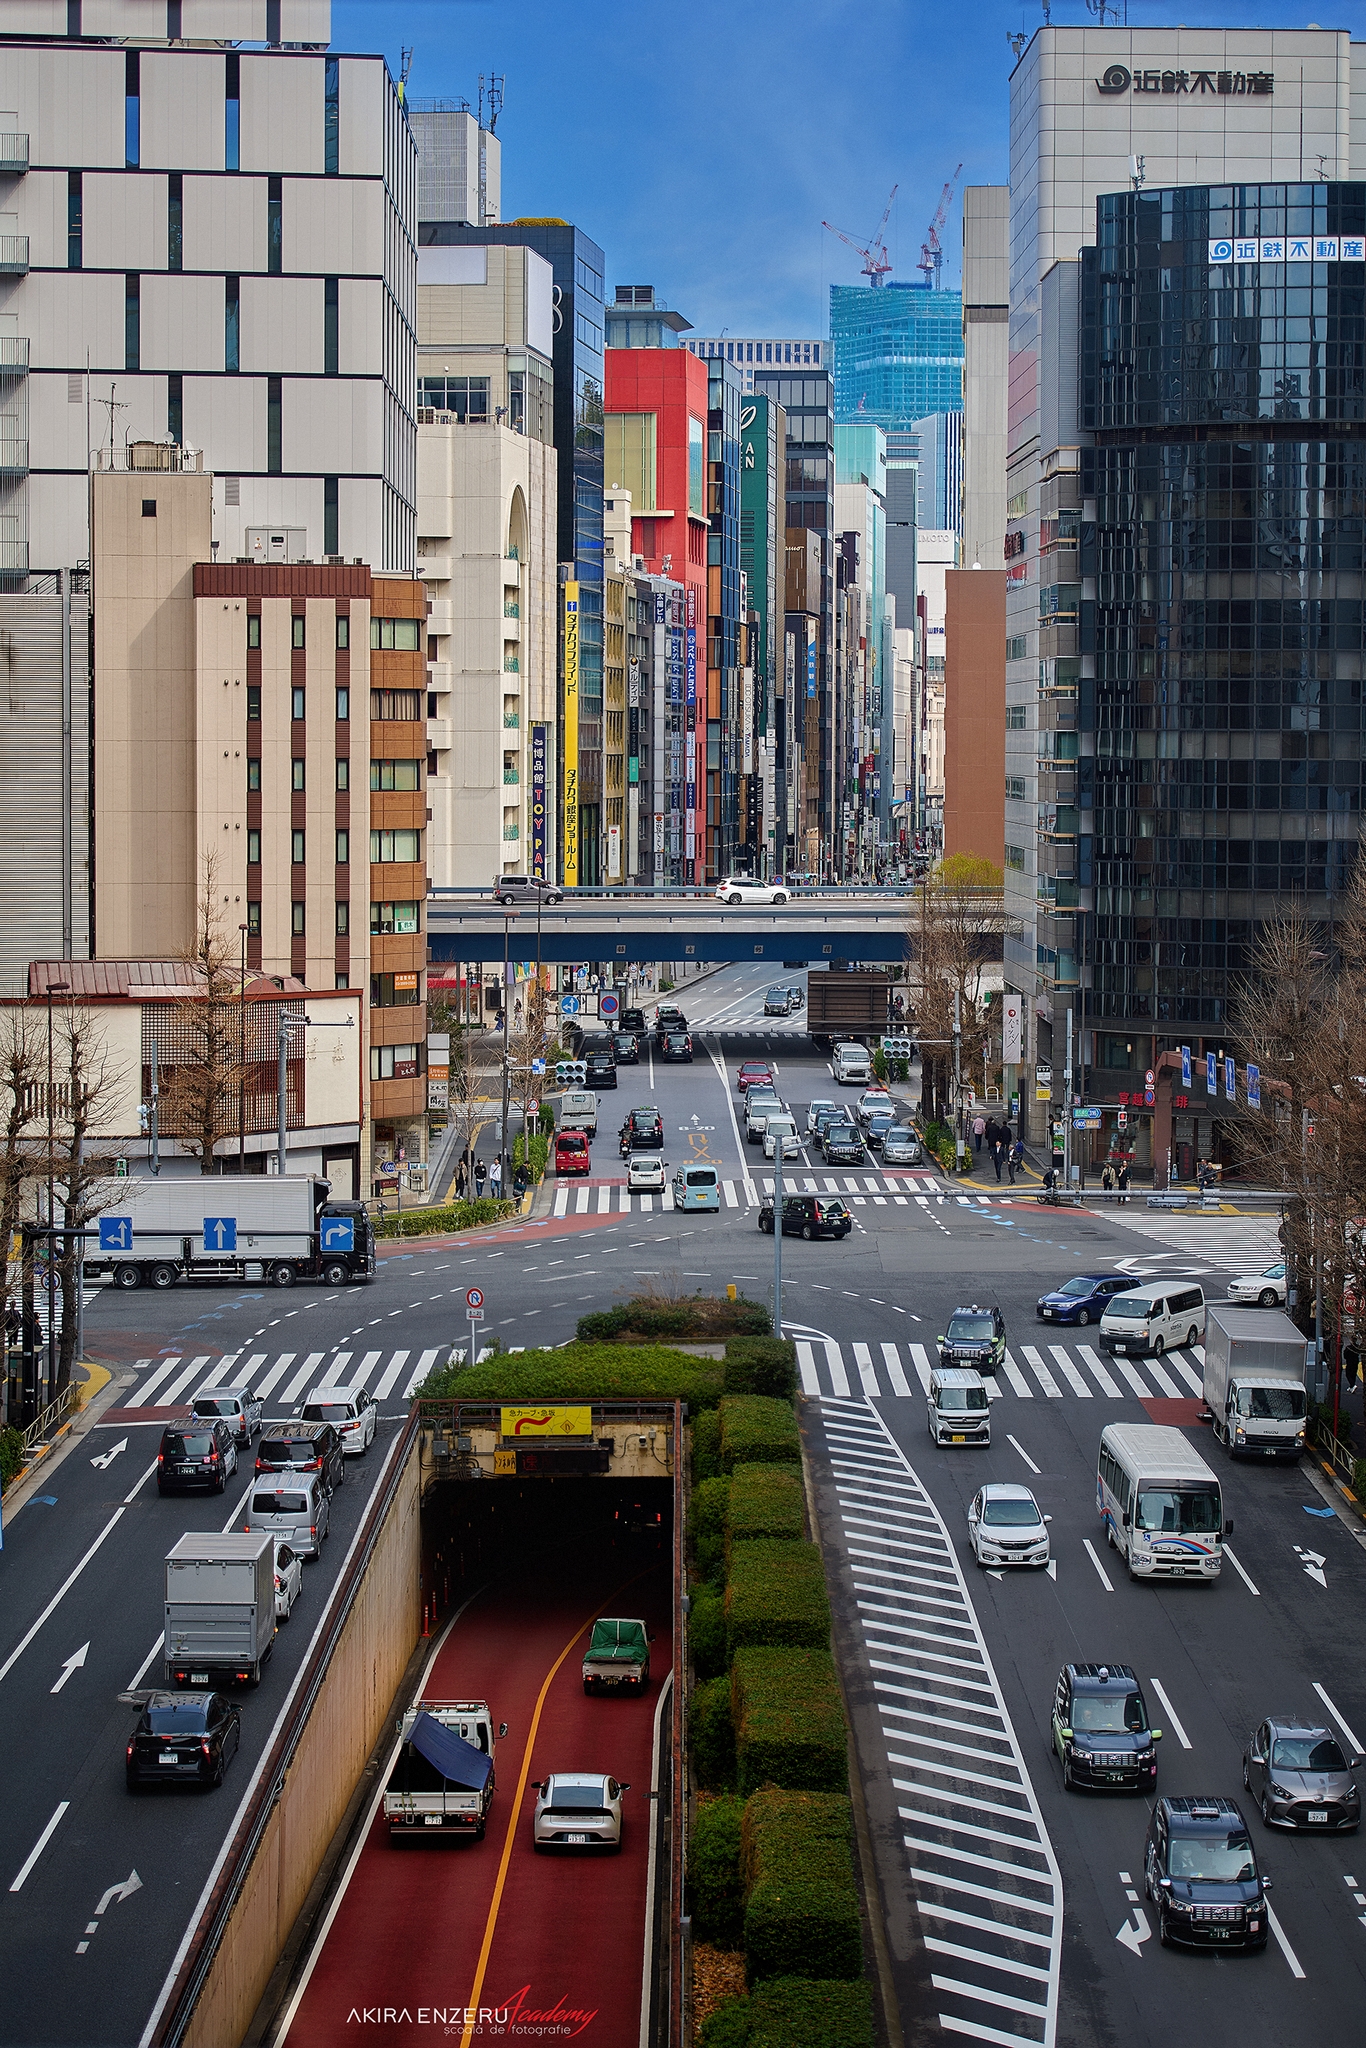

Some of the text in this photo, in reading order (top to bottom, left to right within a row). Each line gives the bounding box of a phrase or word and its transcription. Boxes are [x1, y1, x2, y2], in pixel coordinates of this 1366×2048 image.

[1133, 69, 1275, 95] 近鉄不動産
[1236, 240, 1366, 259] 近鉄不動産
[566, 614, 578, 697] タチカワブラインド
[533, 748, 544, 784] 博品館
[533, 789, 544, 830] TOY
[566, 769, 577, 870] タチカワ銀座ショールーム
[509, 1409, 556, 1418] 急カーブ・急坂
